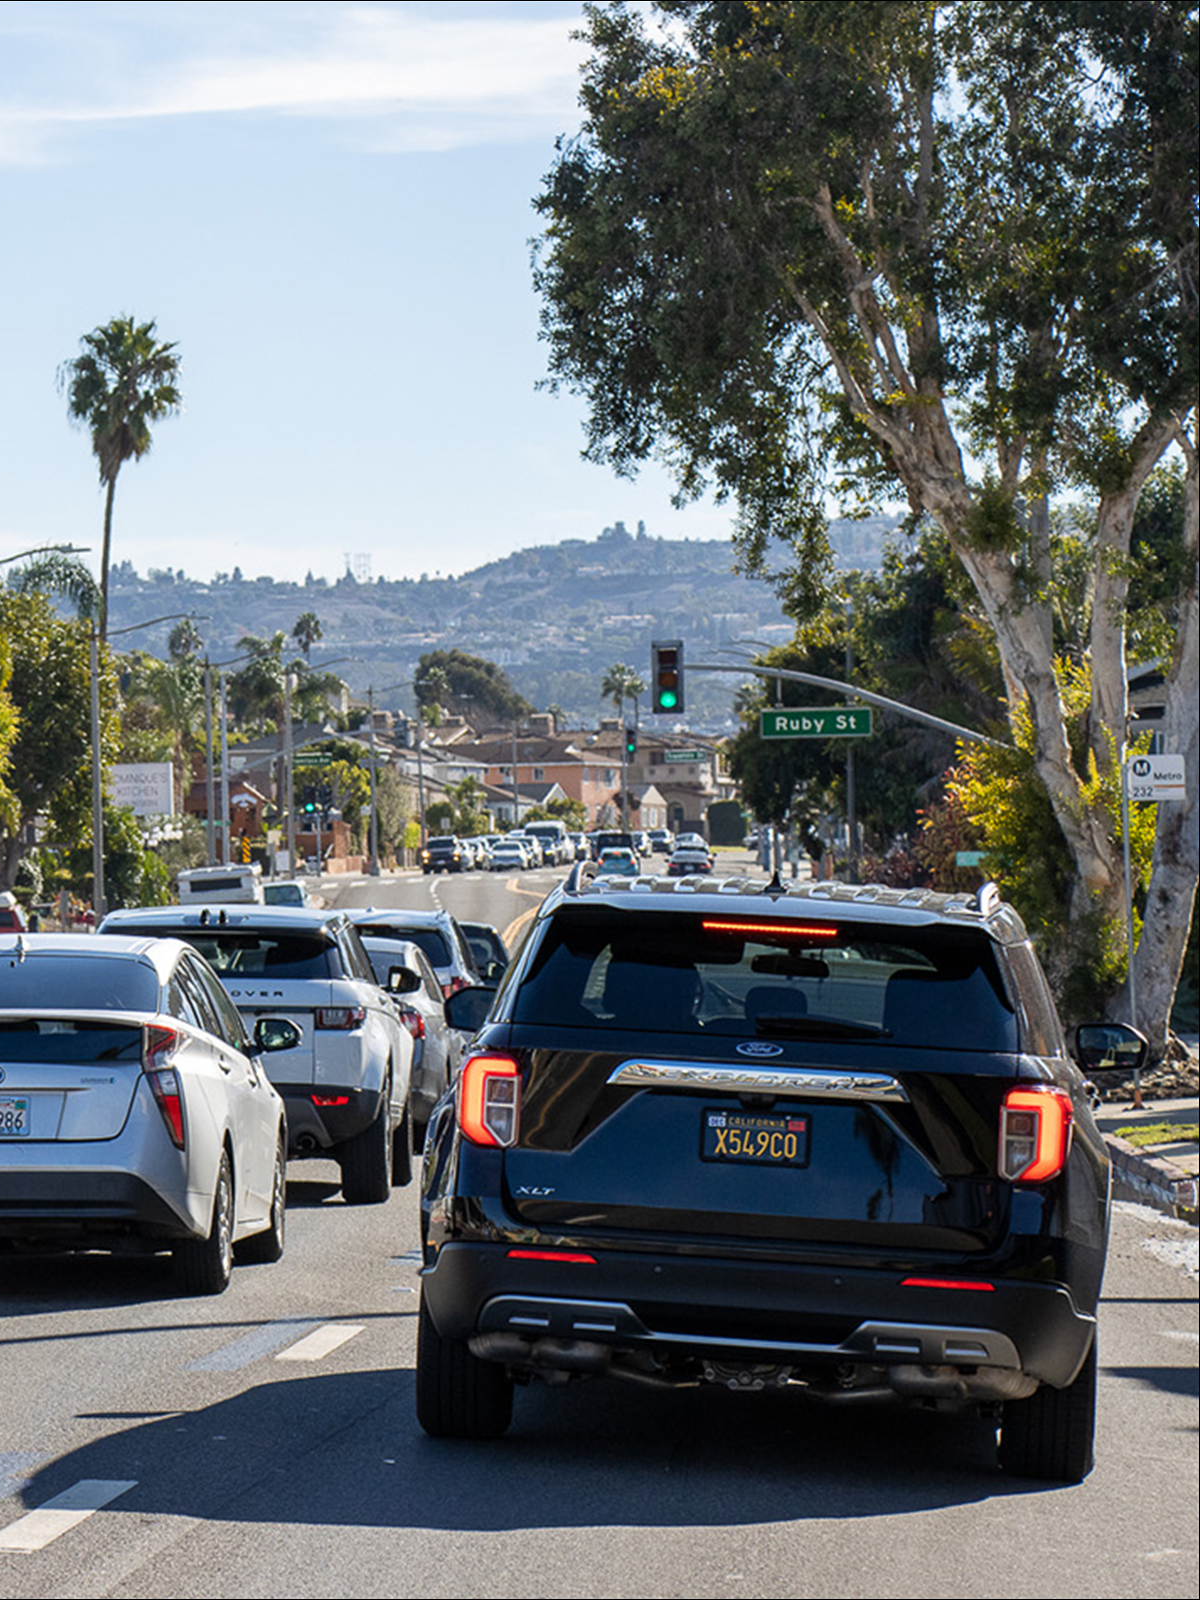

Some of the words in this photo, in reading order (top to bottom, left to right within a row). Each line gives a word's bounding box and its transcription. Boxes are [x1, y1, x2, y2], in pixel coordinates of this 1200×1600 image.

[775, 716, 825, 734] Ruby
[836, 715, 857, 730] St
[1153, 772, 1183, 781] Metro
[230, 990, 284, 998] OVER
[745, 1042, 773, 1054] Ford
[728, 1116, 785, 1128] CALIFORNIA
[515, 1186, 556, 1196] XLT
